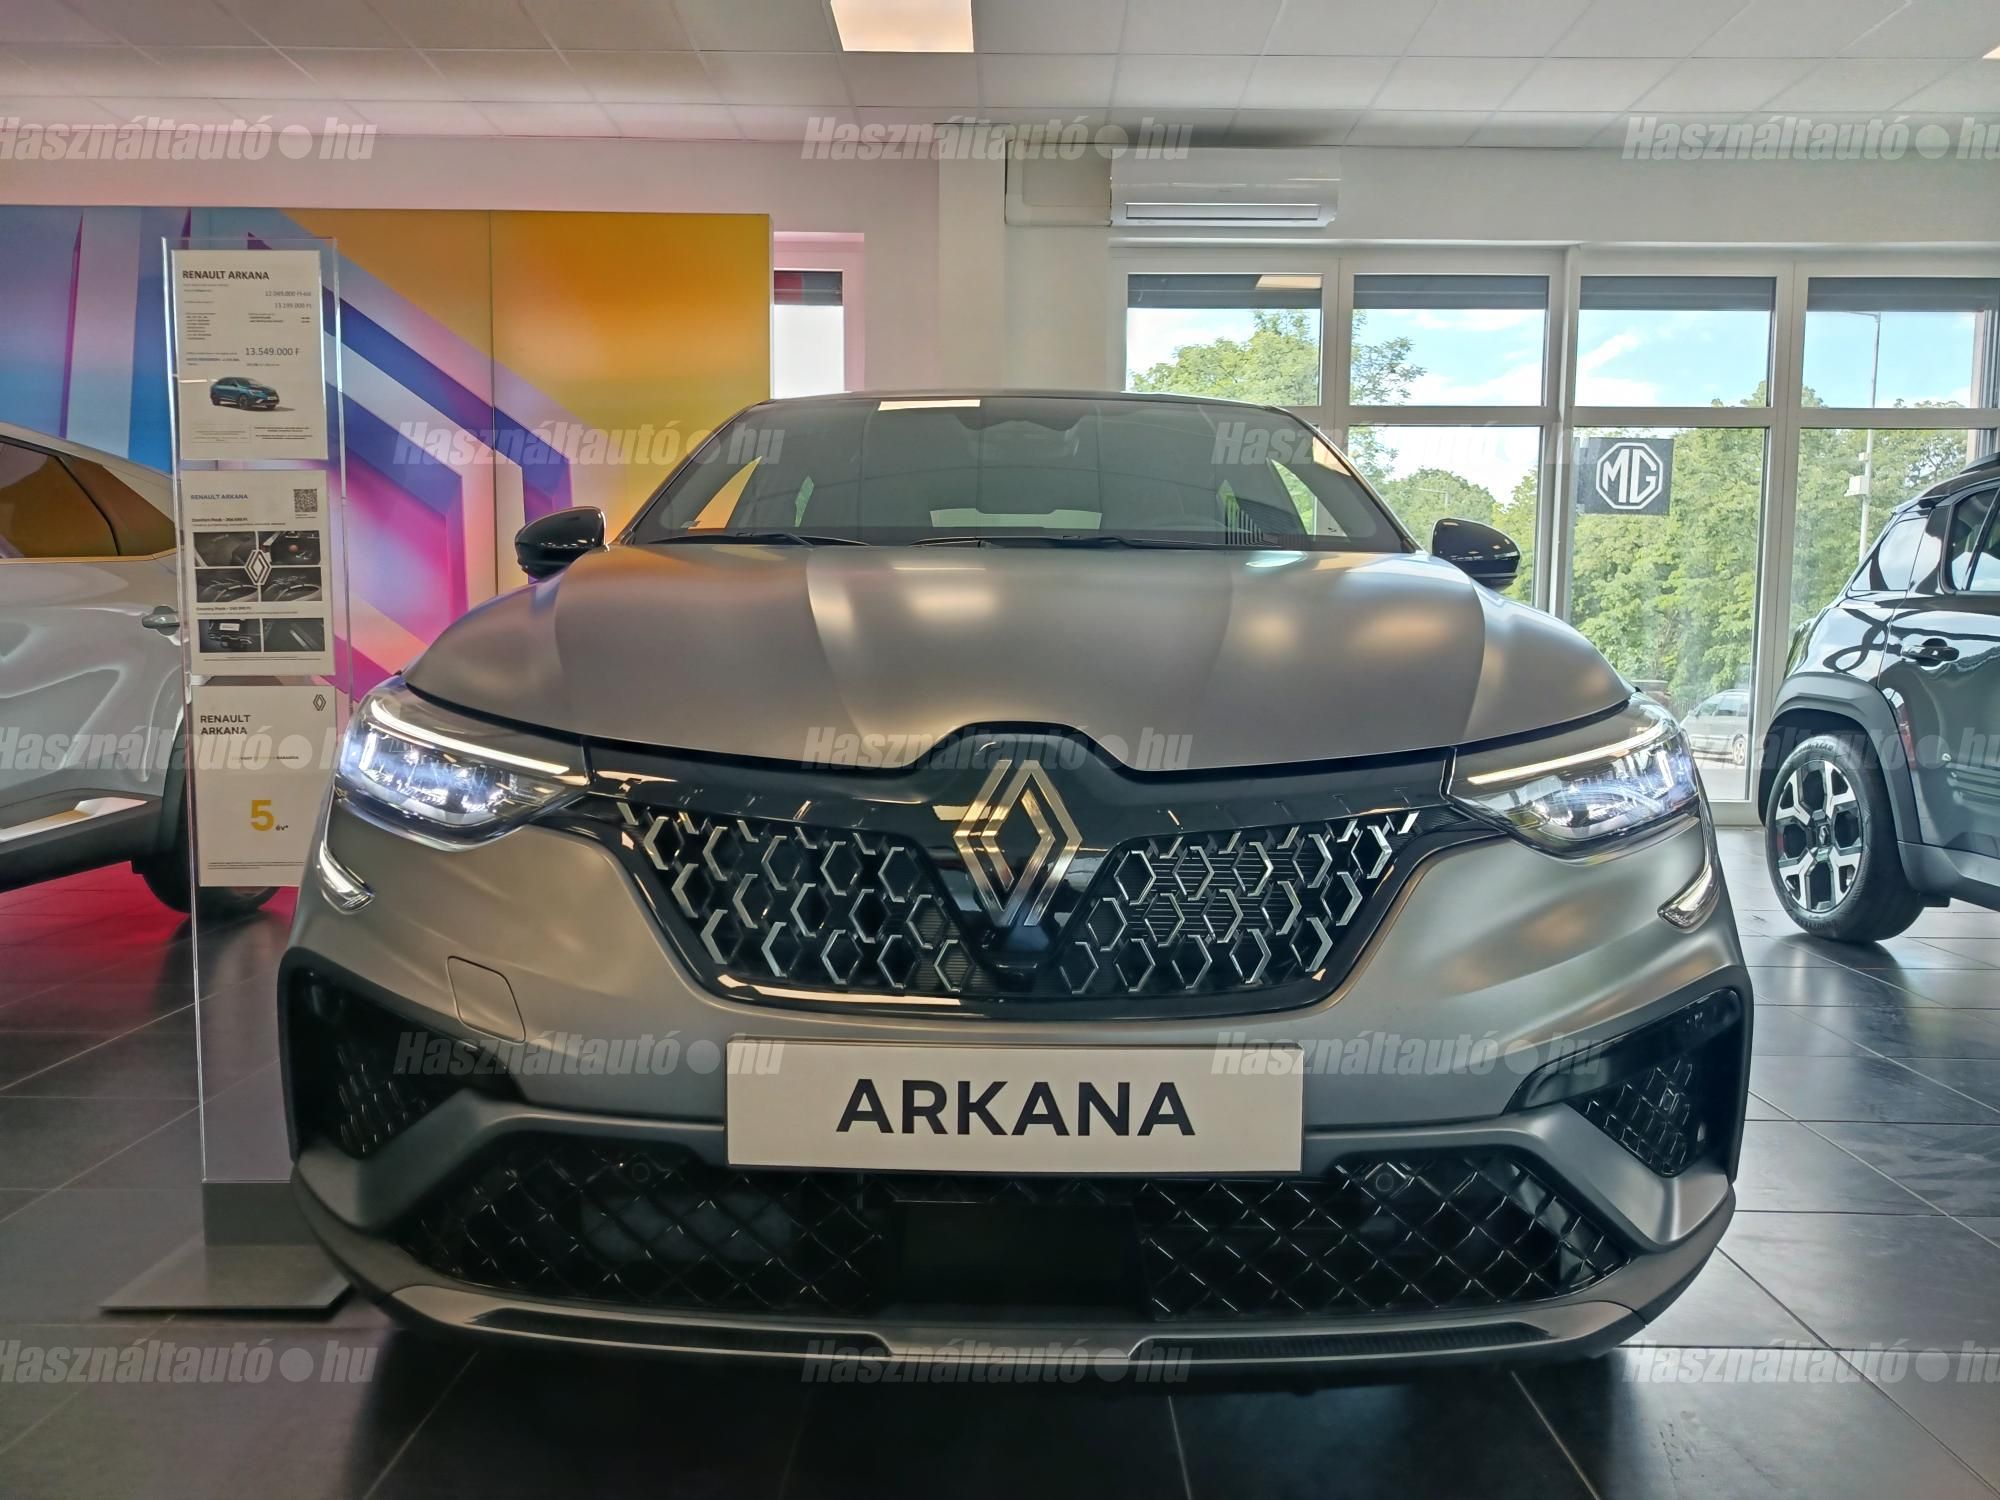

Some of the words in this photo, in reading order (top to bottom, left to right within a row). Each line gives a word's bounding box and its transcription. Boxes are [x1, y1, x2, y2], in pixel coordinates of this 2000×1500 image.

[182, 270, 226, 279] RENAULT
[228, 271, 269, 280] ARKANA
[1602, 448, 1657, 504] MG
[200, 714, 251, 724] RENAULT
[201, 726, 247, 736] ARKANA
[250, 799, 275, 831] 5
[836, 1078, 1195, 1137] ARKANA
